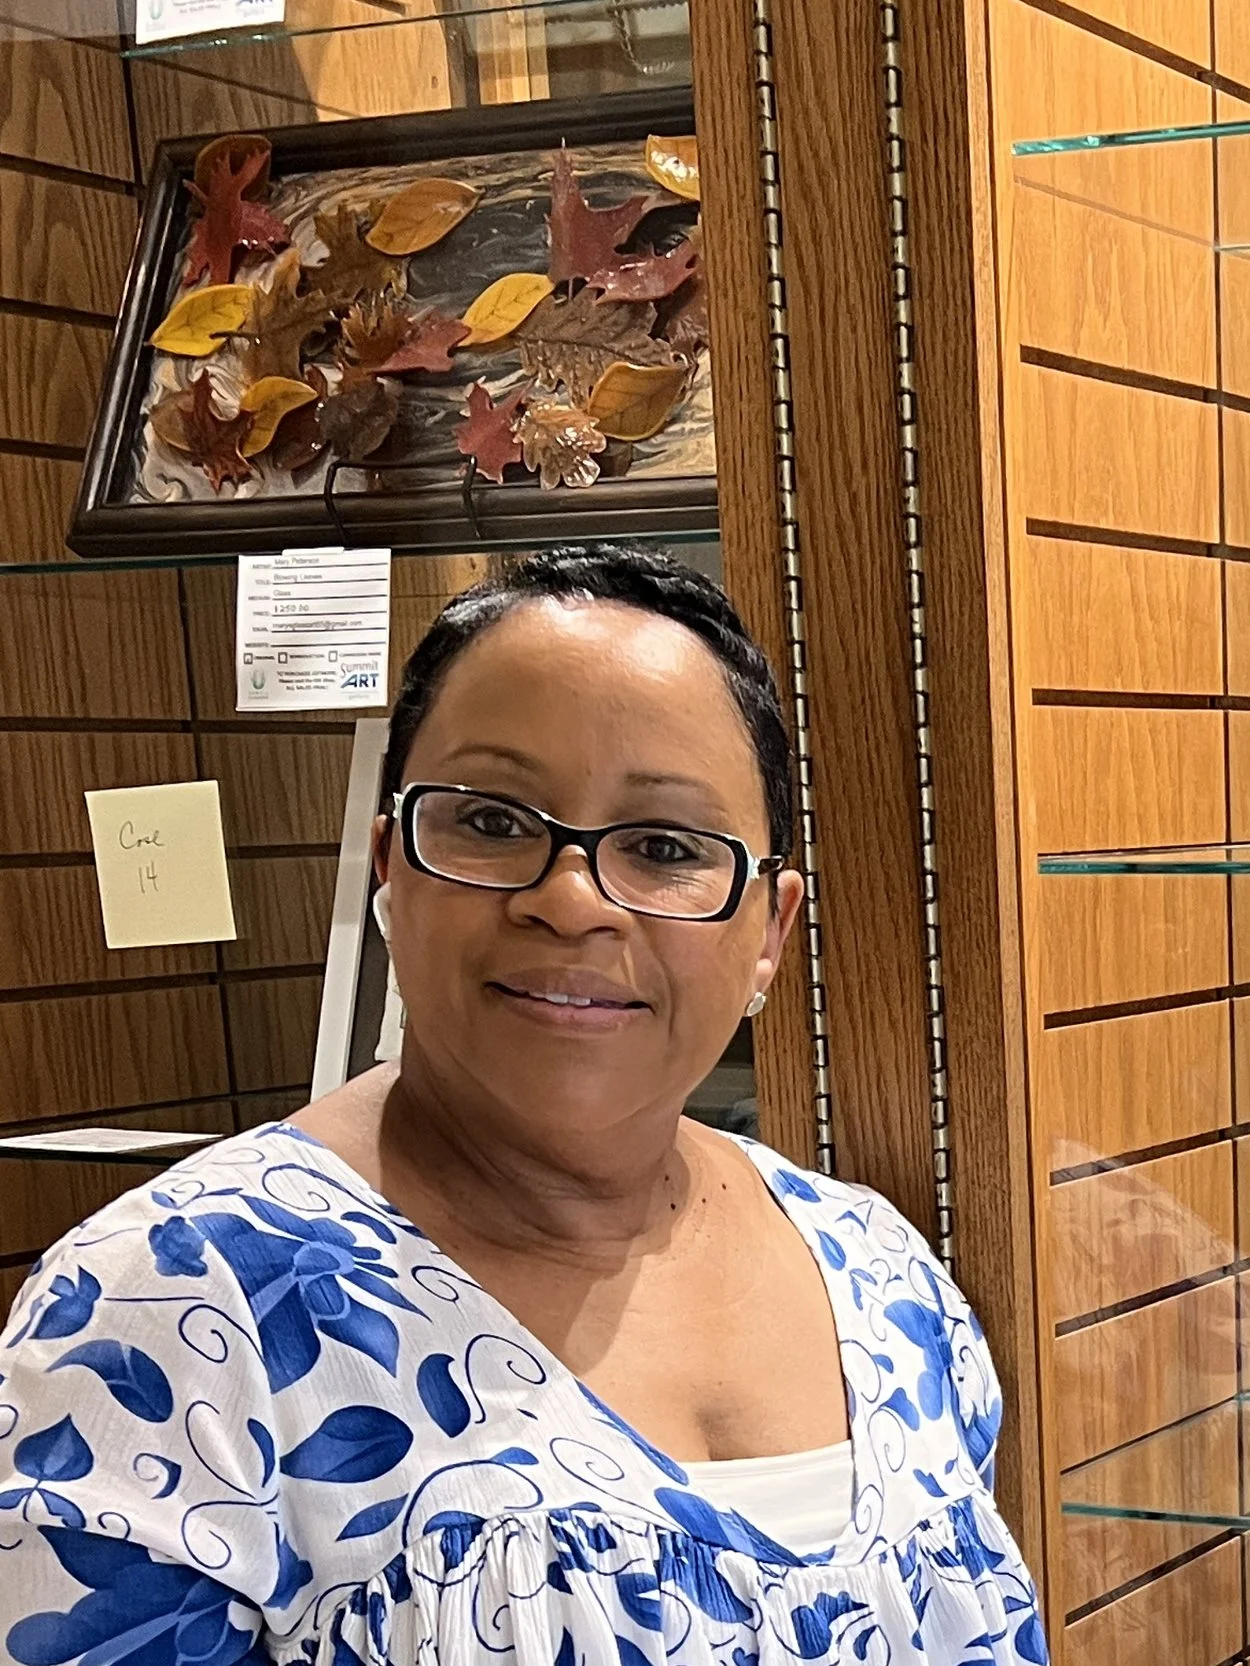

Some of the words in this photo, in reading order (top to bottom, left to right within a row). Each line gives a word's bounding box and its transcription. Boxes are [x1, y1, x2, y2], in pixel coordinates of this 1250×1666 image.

[340, 660, 378, 678] Summit
[340, 674, 379, 688] ART
[119, 821, 165, 849] Case
[139, 860, 159, 894] 14
